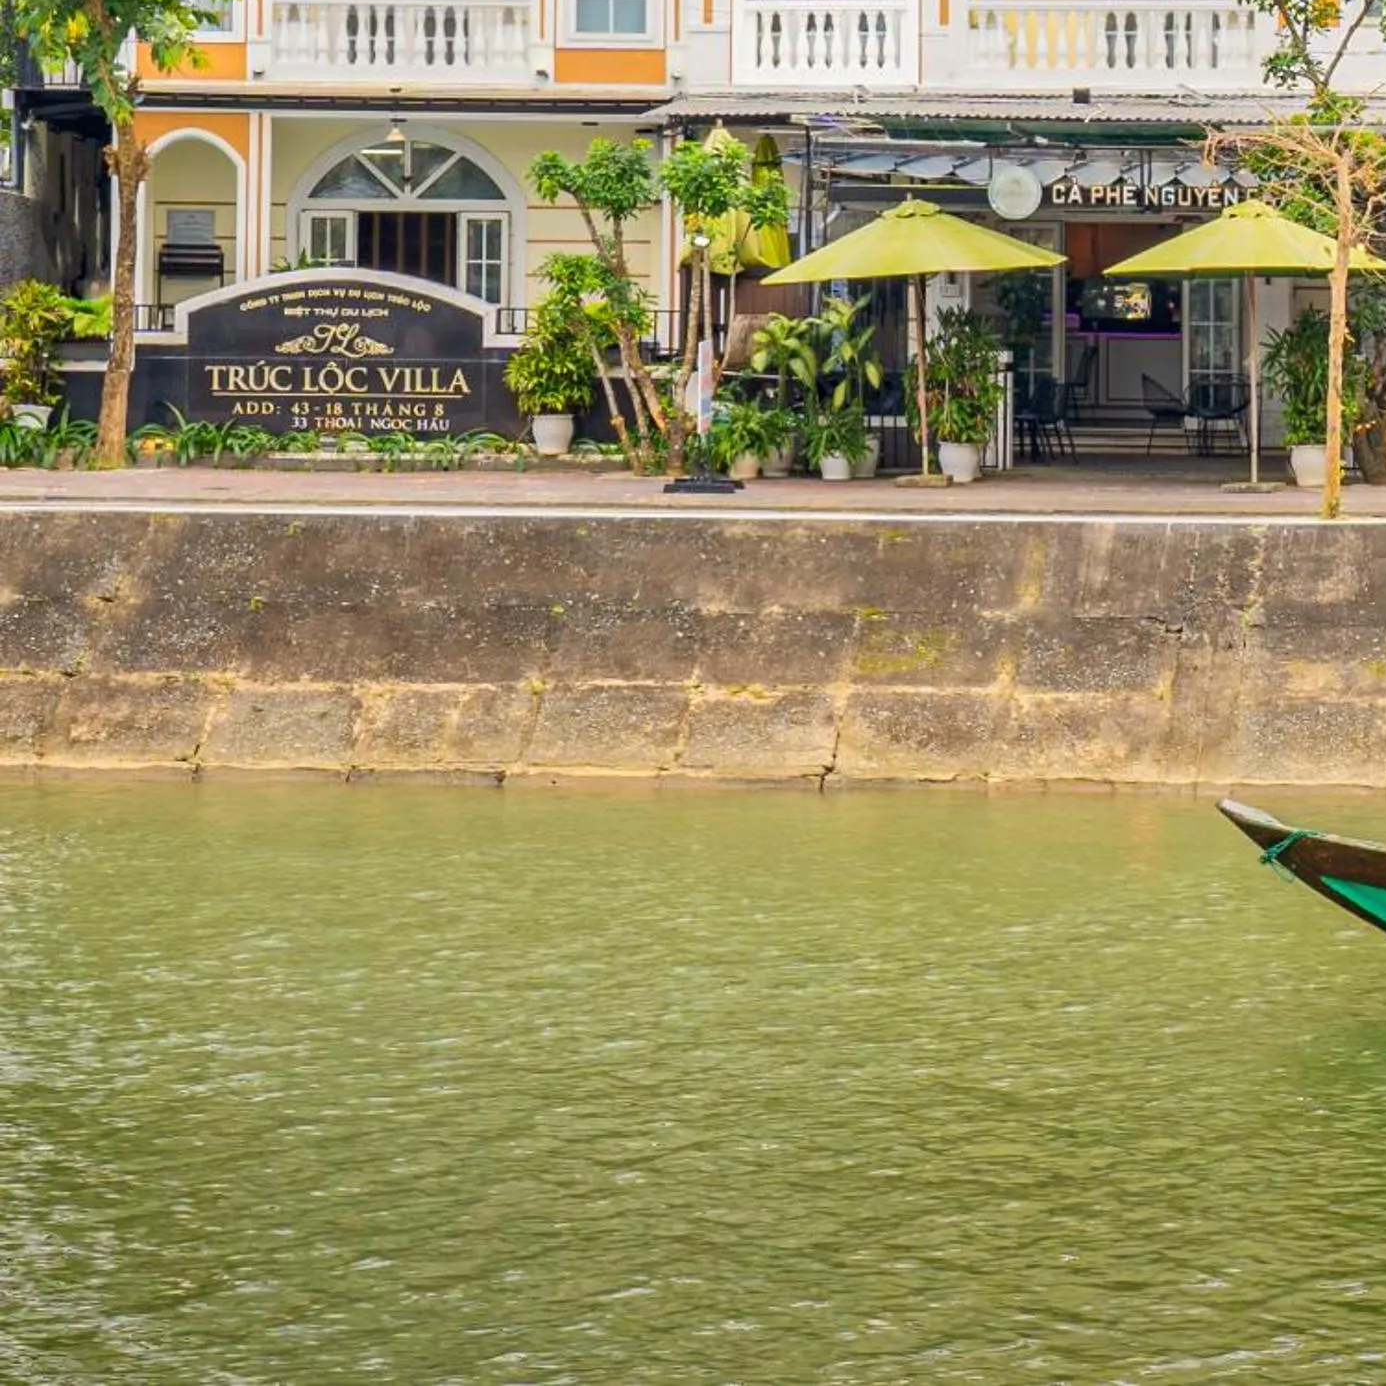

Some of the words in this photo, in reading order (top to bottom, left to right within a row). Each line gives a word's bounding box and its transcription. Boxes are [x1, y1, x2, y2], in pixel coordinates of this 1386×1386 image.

[204, 360, 292, 391] TRÚC
[301, 361, 369, 395] LỘC
[377, 366, 472, 394] VILLA
[232, 401, 281, 415] ADD:
[351, 399, 426, 417] THÁNG
[434, 403, 445, 417] 8
[291, 417, 308, 429] 33
